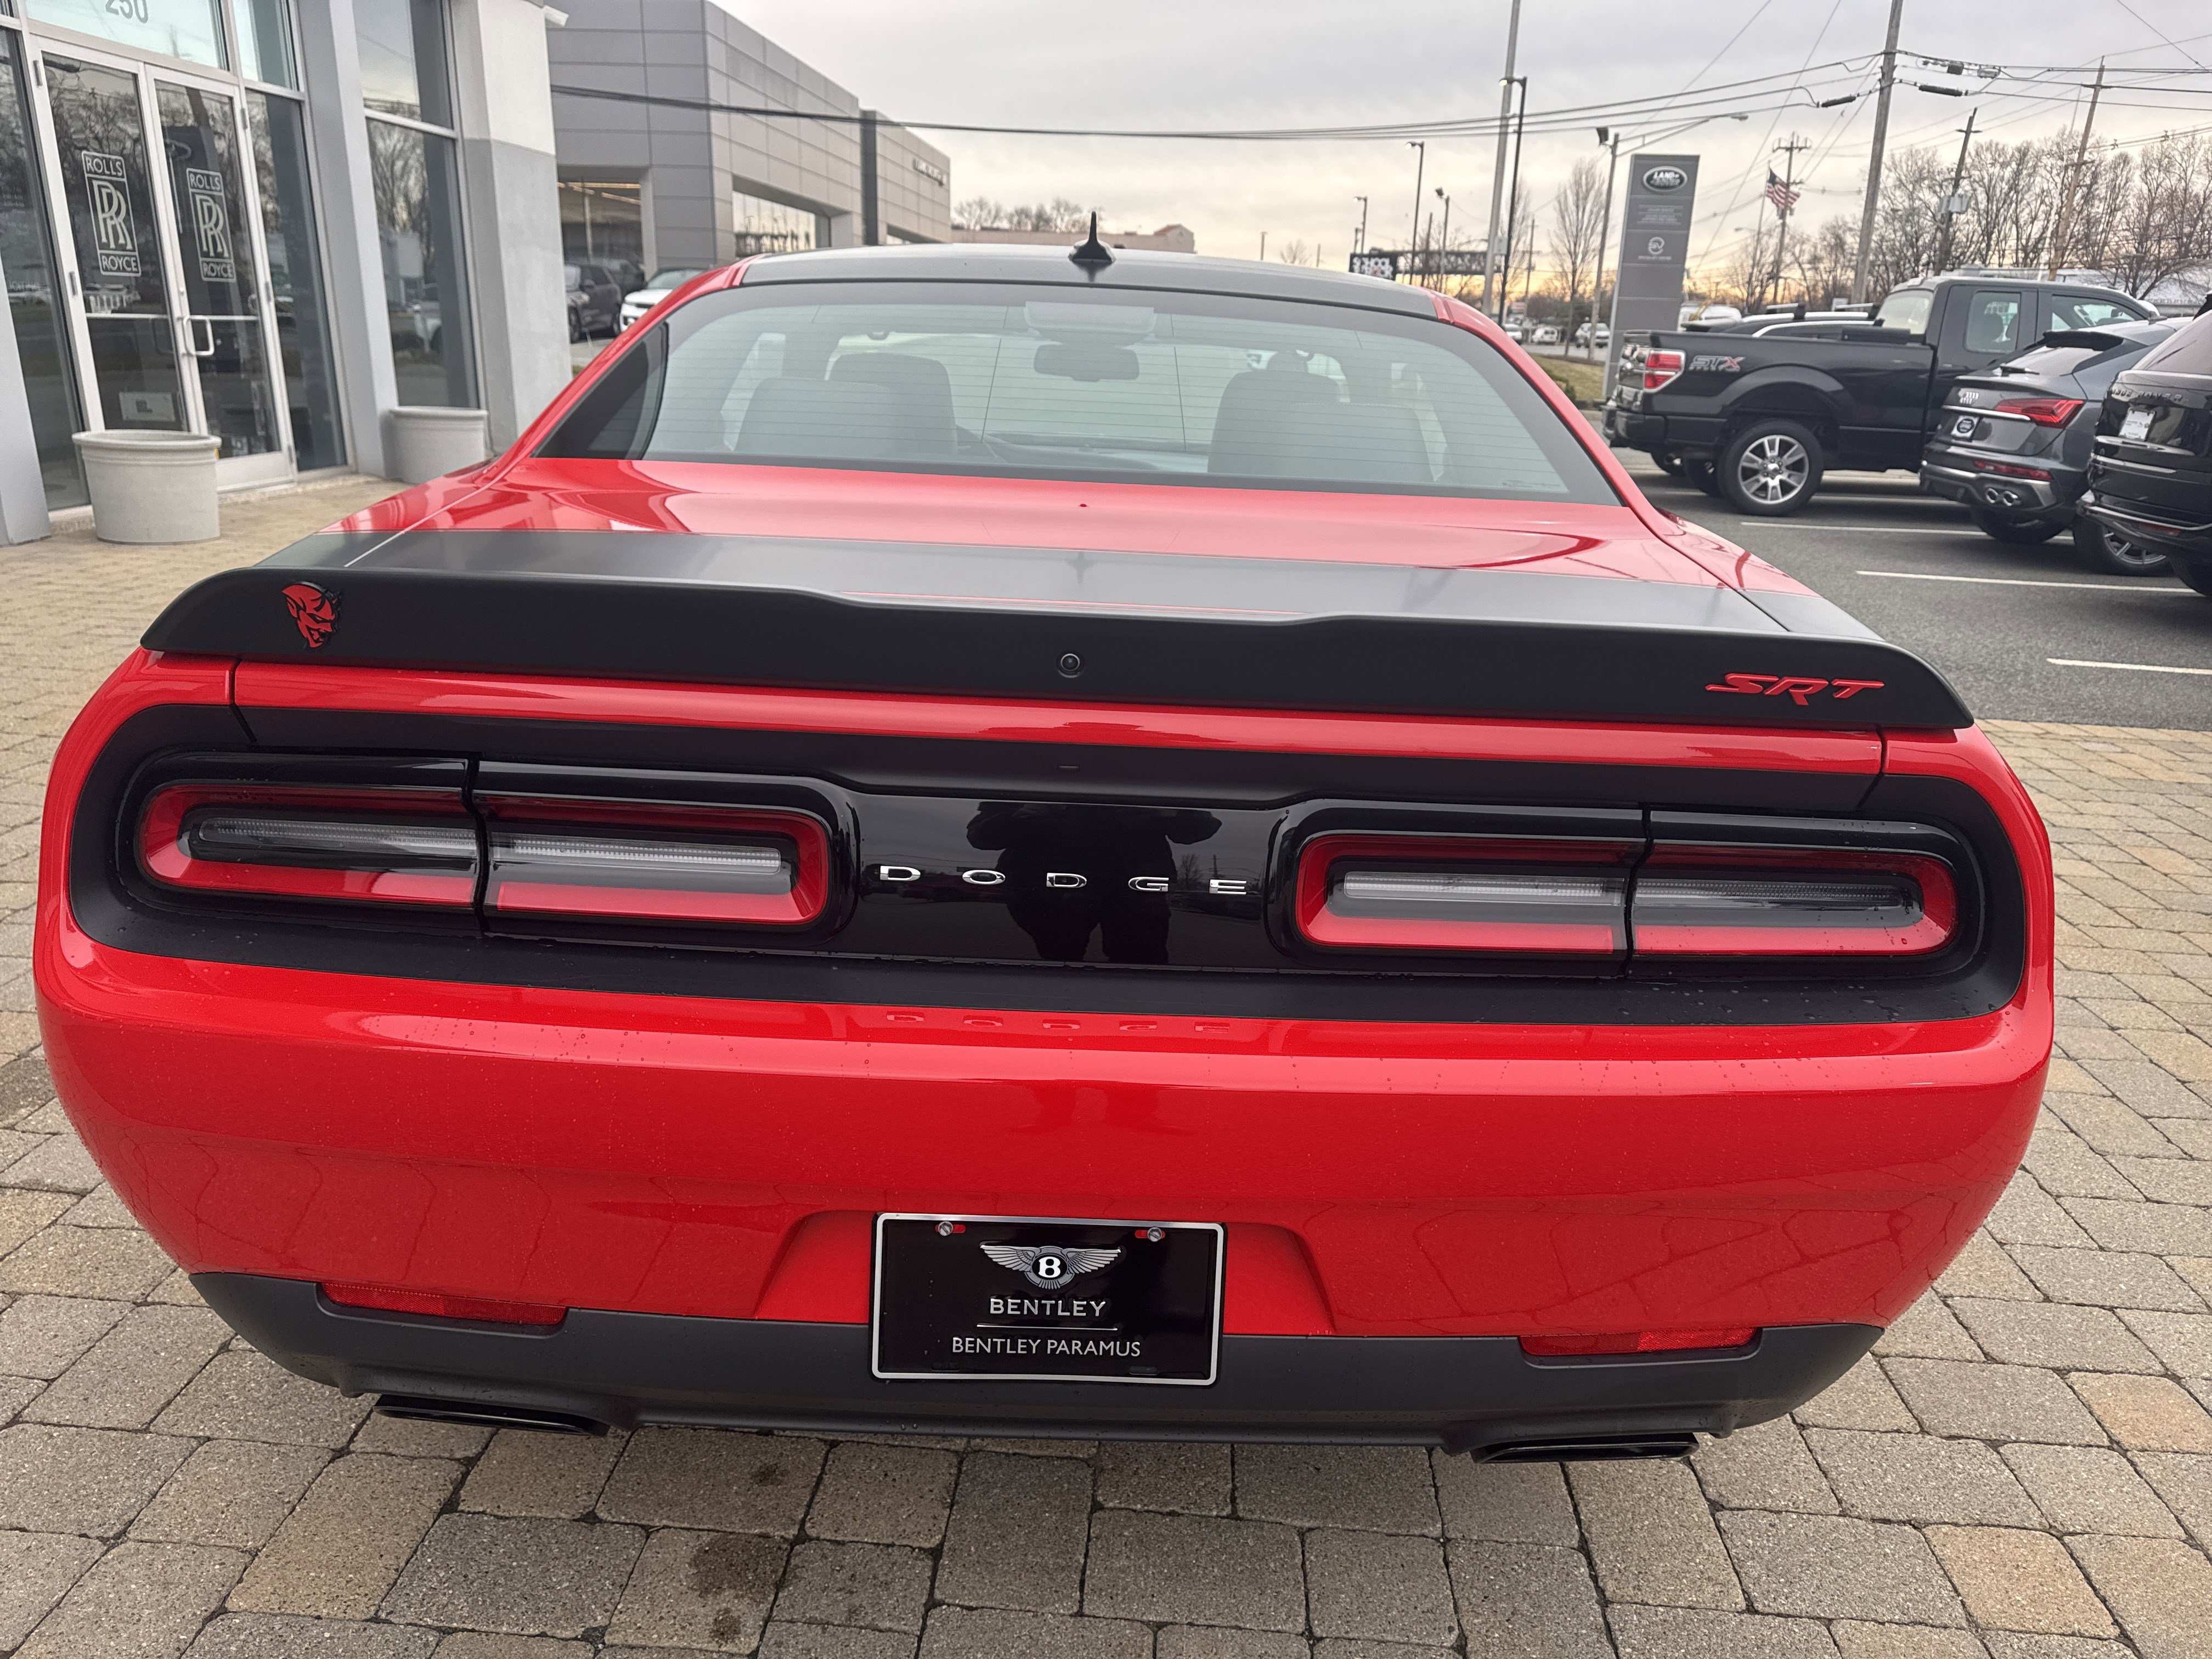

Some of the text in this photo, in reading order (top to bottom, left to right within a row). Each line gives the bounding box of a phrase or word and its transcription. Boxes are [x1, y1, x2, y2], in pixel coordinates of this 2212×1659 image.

[85, 156, 123, 176] ROLLS
[189, 174, 221, 190] ROLLS
[101, 255, 137, 272] ROYCE
[202, 262, 233, 278] ROYCE
[1705, 673, 1885, 706] SRT
[880, 865, 1247, 895] DODGE
[989, 1298, 1106, 1317] BENTLEY
[952, 1337, 1141, 1357] BENTLEY PARAMUS
